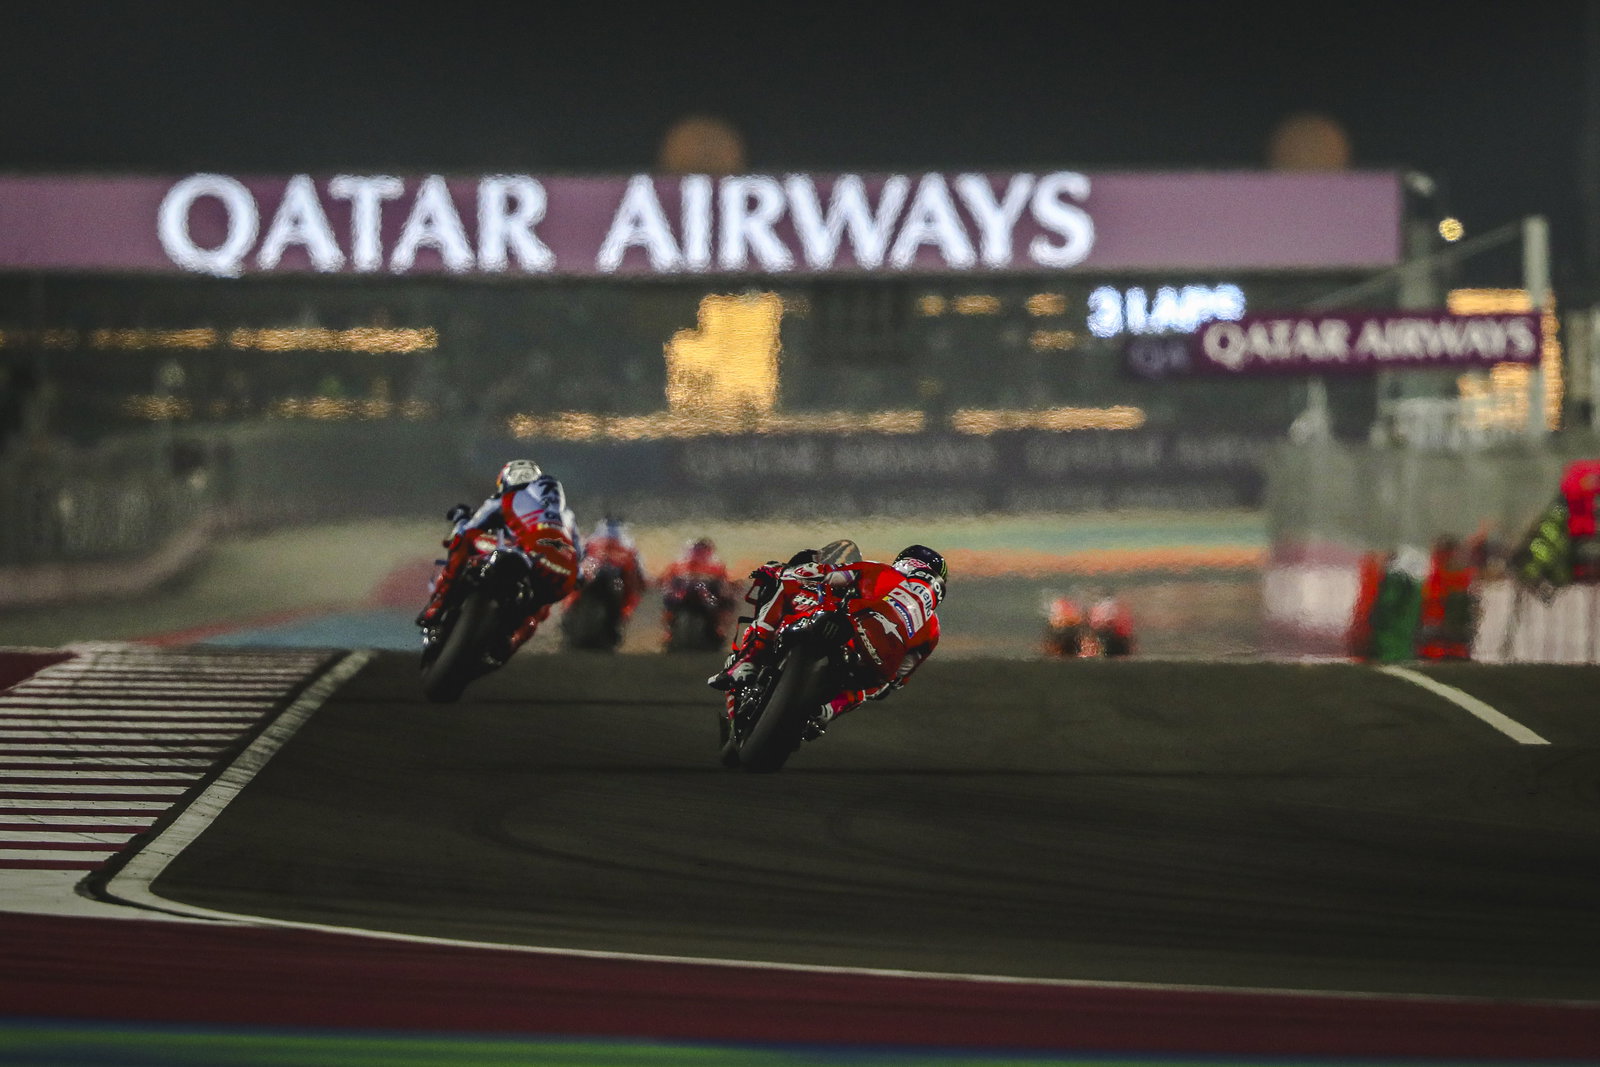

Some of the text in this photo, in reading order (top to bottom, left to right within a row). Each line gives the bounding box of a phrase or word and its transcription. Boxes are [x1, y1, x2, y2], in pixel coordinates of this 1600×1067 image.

[157, 171, 1097, 277] QATAR AIRWAYS
[1087, 285, 1123, 338] 3
[1203, 318, 1351, 371] QATAR
[1354, 316, 1536, 360] AIRWAYS
